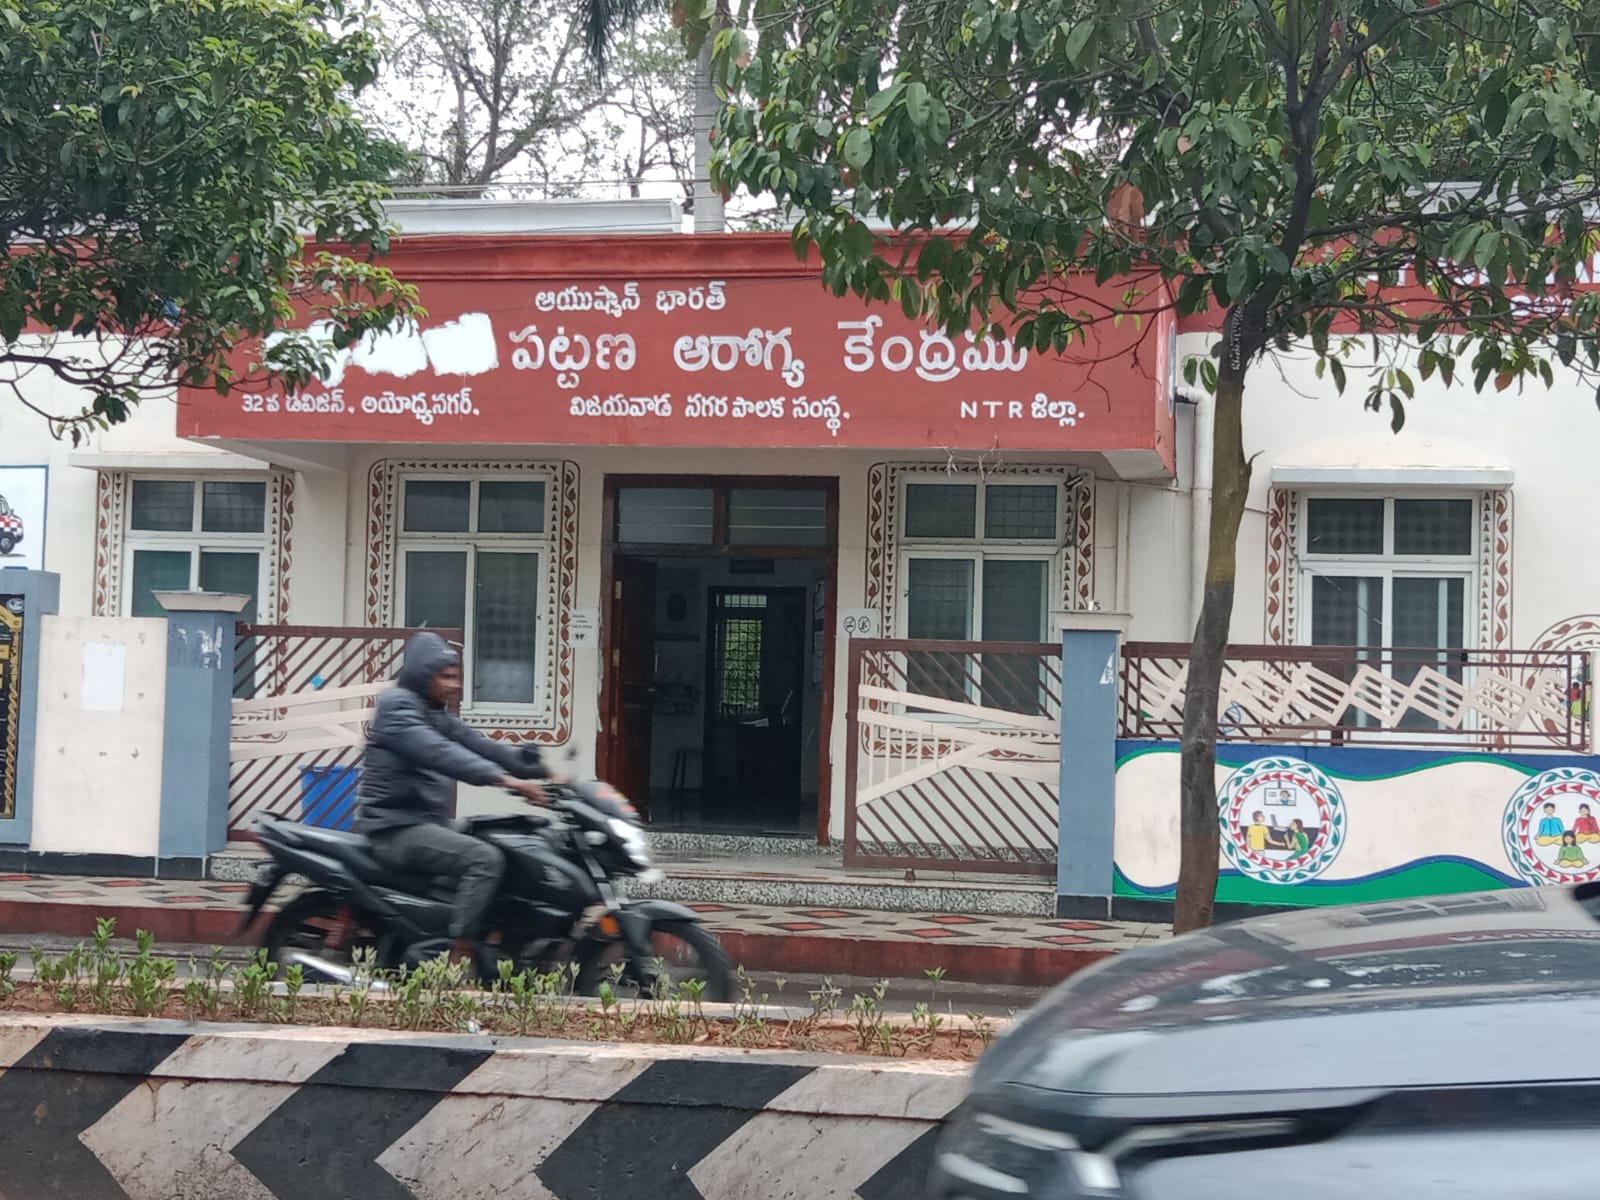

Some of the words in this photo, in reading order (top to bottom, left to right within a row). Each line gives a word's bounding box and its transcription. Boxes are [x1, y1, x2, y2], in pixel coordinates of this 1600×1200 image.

[656, 281, 726, 314] భారత్
[510, 325, 638, 389] పట్టణ
[673, 327, 804, 388] ఆరోగ్య
[570, 393, 672, 417] విజయవాడ
[1031, 393, 1085, 426] జిల్లా.
